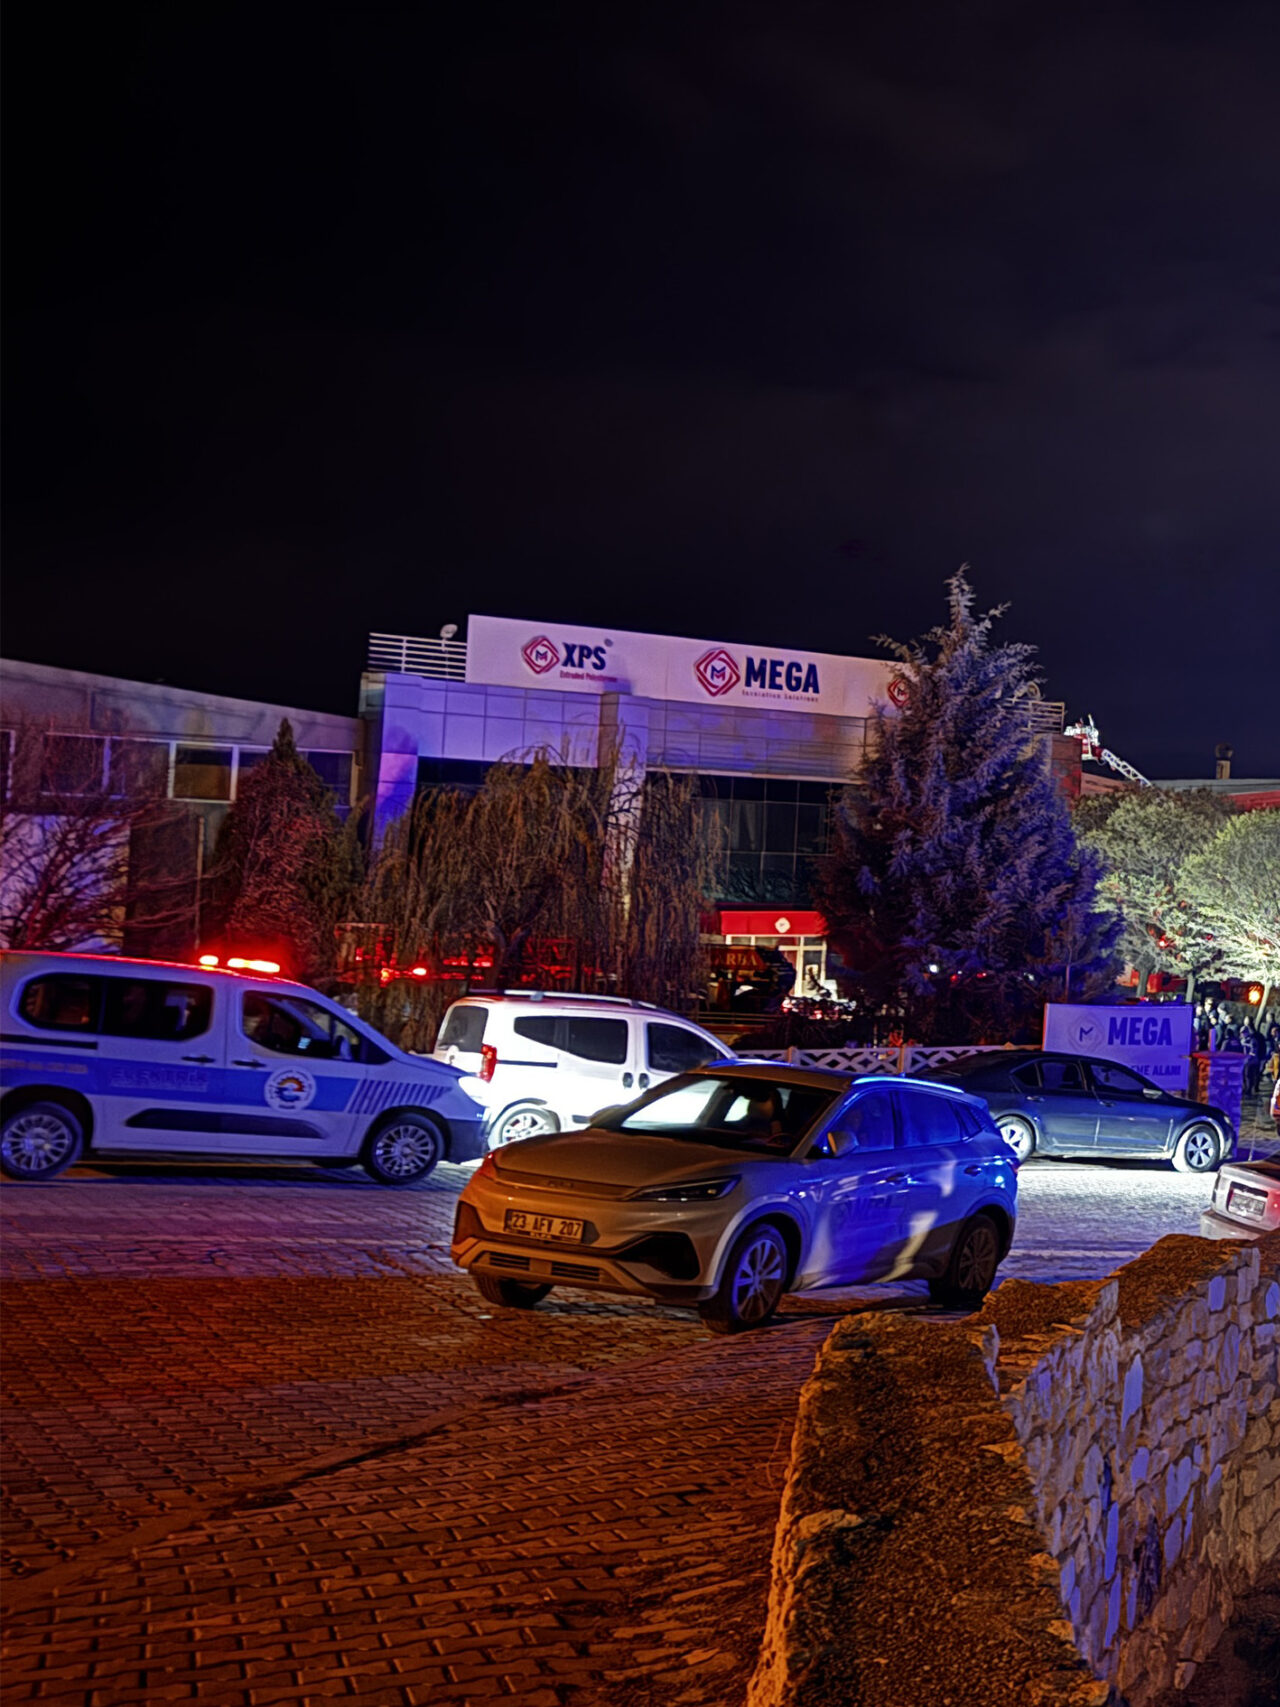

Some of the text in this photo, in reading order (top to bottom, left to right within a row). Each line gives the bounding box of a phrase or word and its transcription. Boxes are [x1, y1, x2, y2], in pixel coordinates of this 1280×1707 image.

[561, 642, 607, 671] XPS
[744, 656, 820, 694] MEGA
[1107, 1016, 1173, 1046] MEGA
[512, 1213, 527, 1230] 23
[559, 1221, 582, 1237] 207
